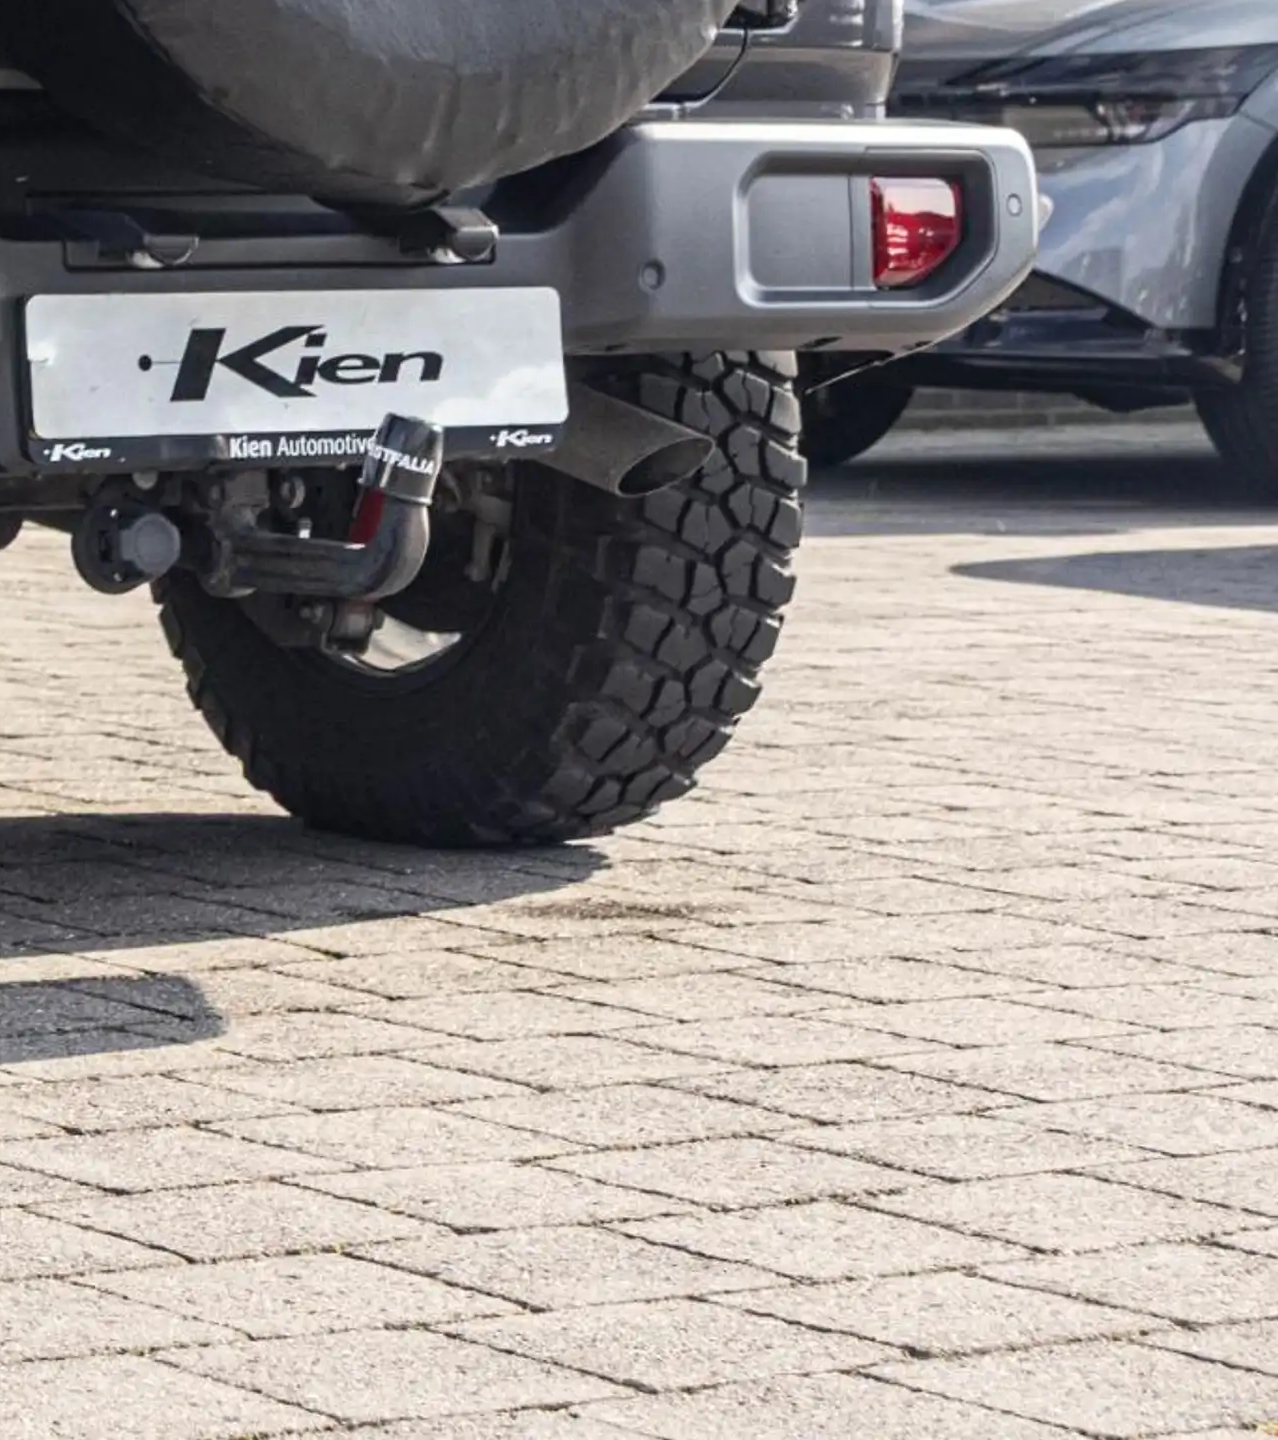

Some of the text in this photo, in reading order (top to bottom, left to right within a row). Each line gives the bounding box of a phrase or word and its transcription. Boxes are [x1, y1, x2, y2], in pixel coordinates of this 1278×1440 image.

[169, 324, 445, 403] Kien
[229, 435, 272, 459] Kien
[496, 428, 554, 448] Kien
[49, 442, 112, 462] Kien
